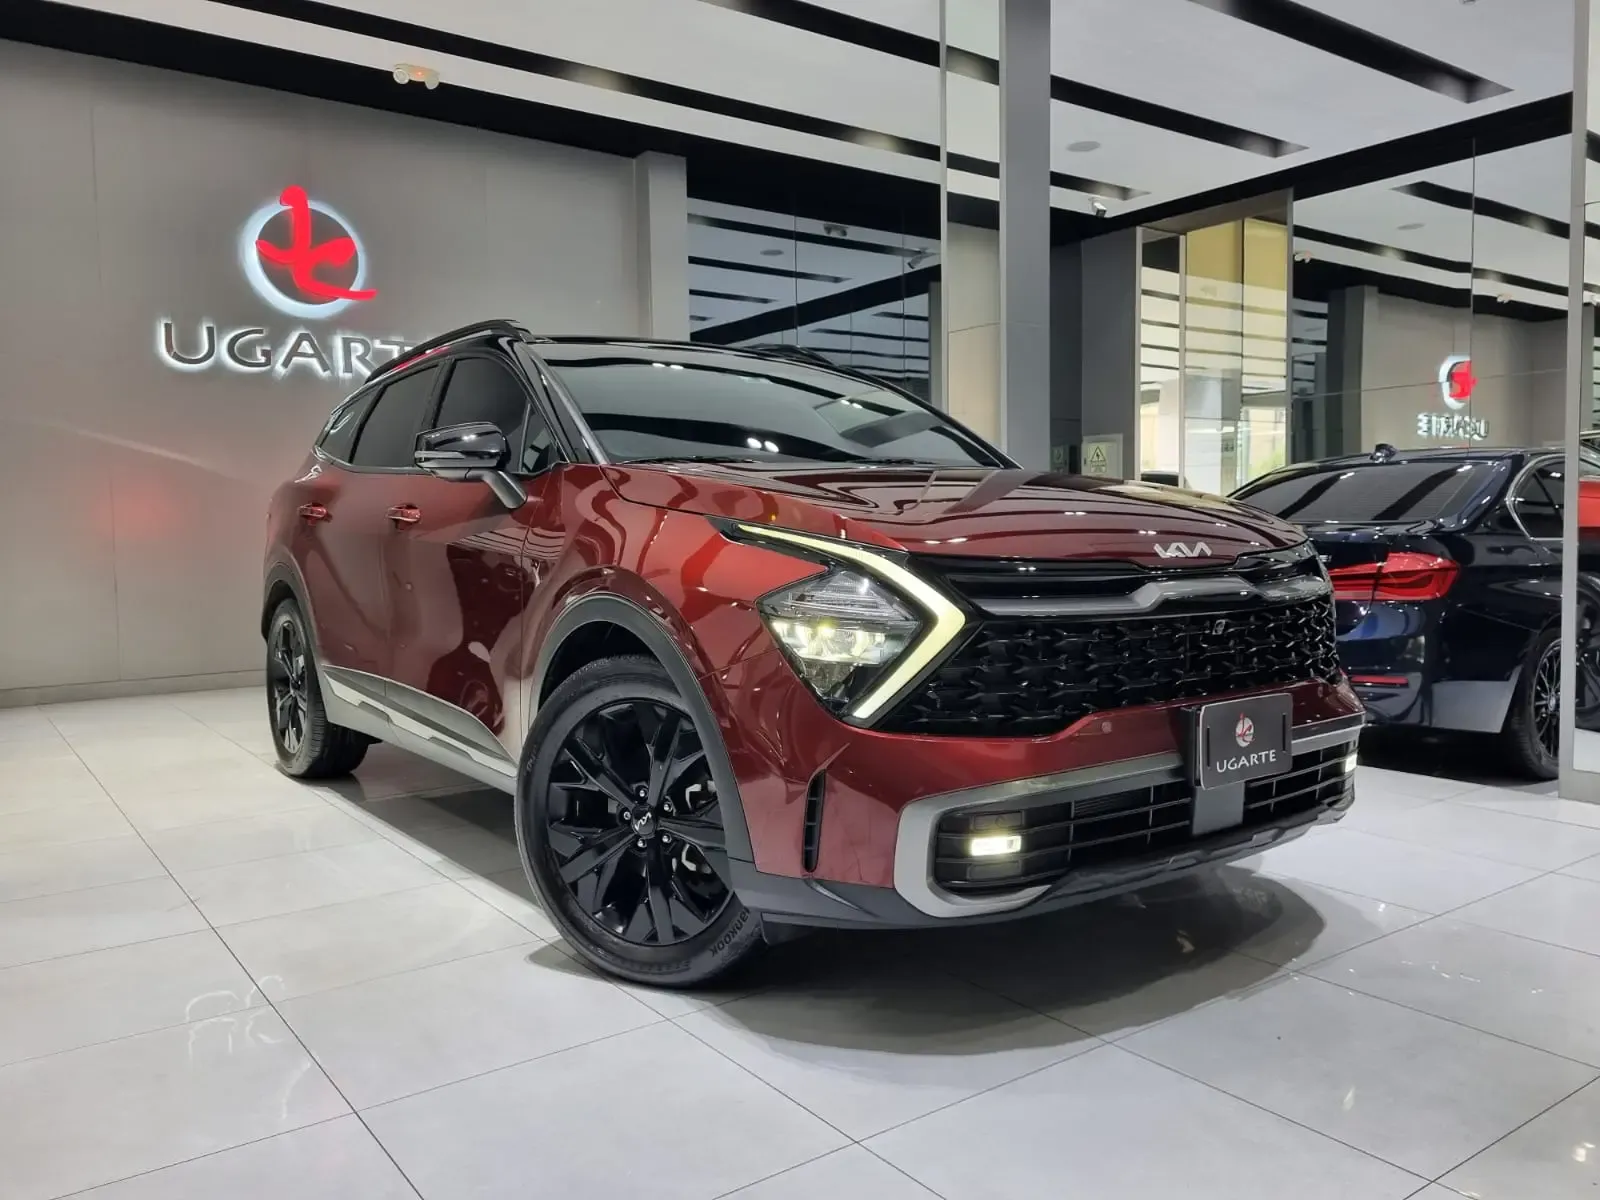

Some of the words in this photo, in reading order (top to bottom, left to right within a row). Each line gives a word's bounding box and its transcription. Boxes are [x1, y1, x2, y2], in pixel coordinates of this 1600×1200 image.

[158, 319, 421, 377] UGART
[1153, 542, 1212, 558] KIA
[1216, 749, 1277, 773] UGARTE
